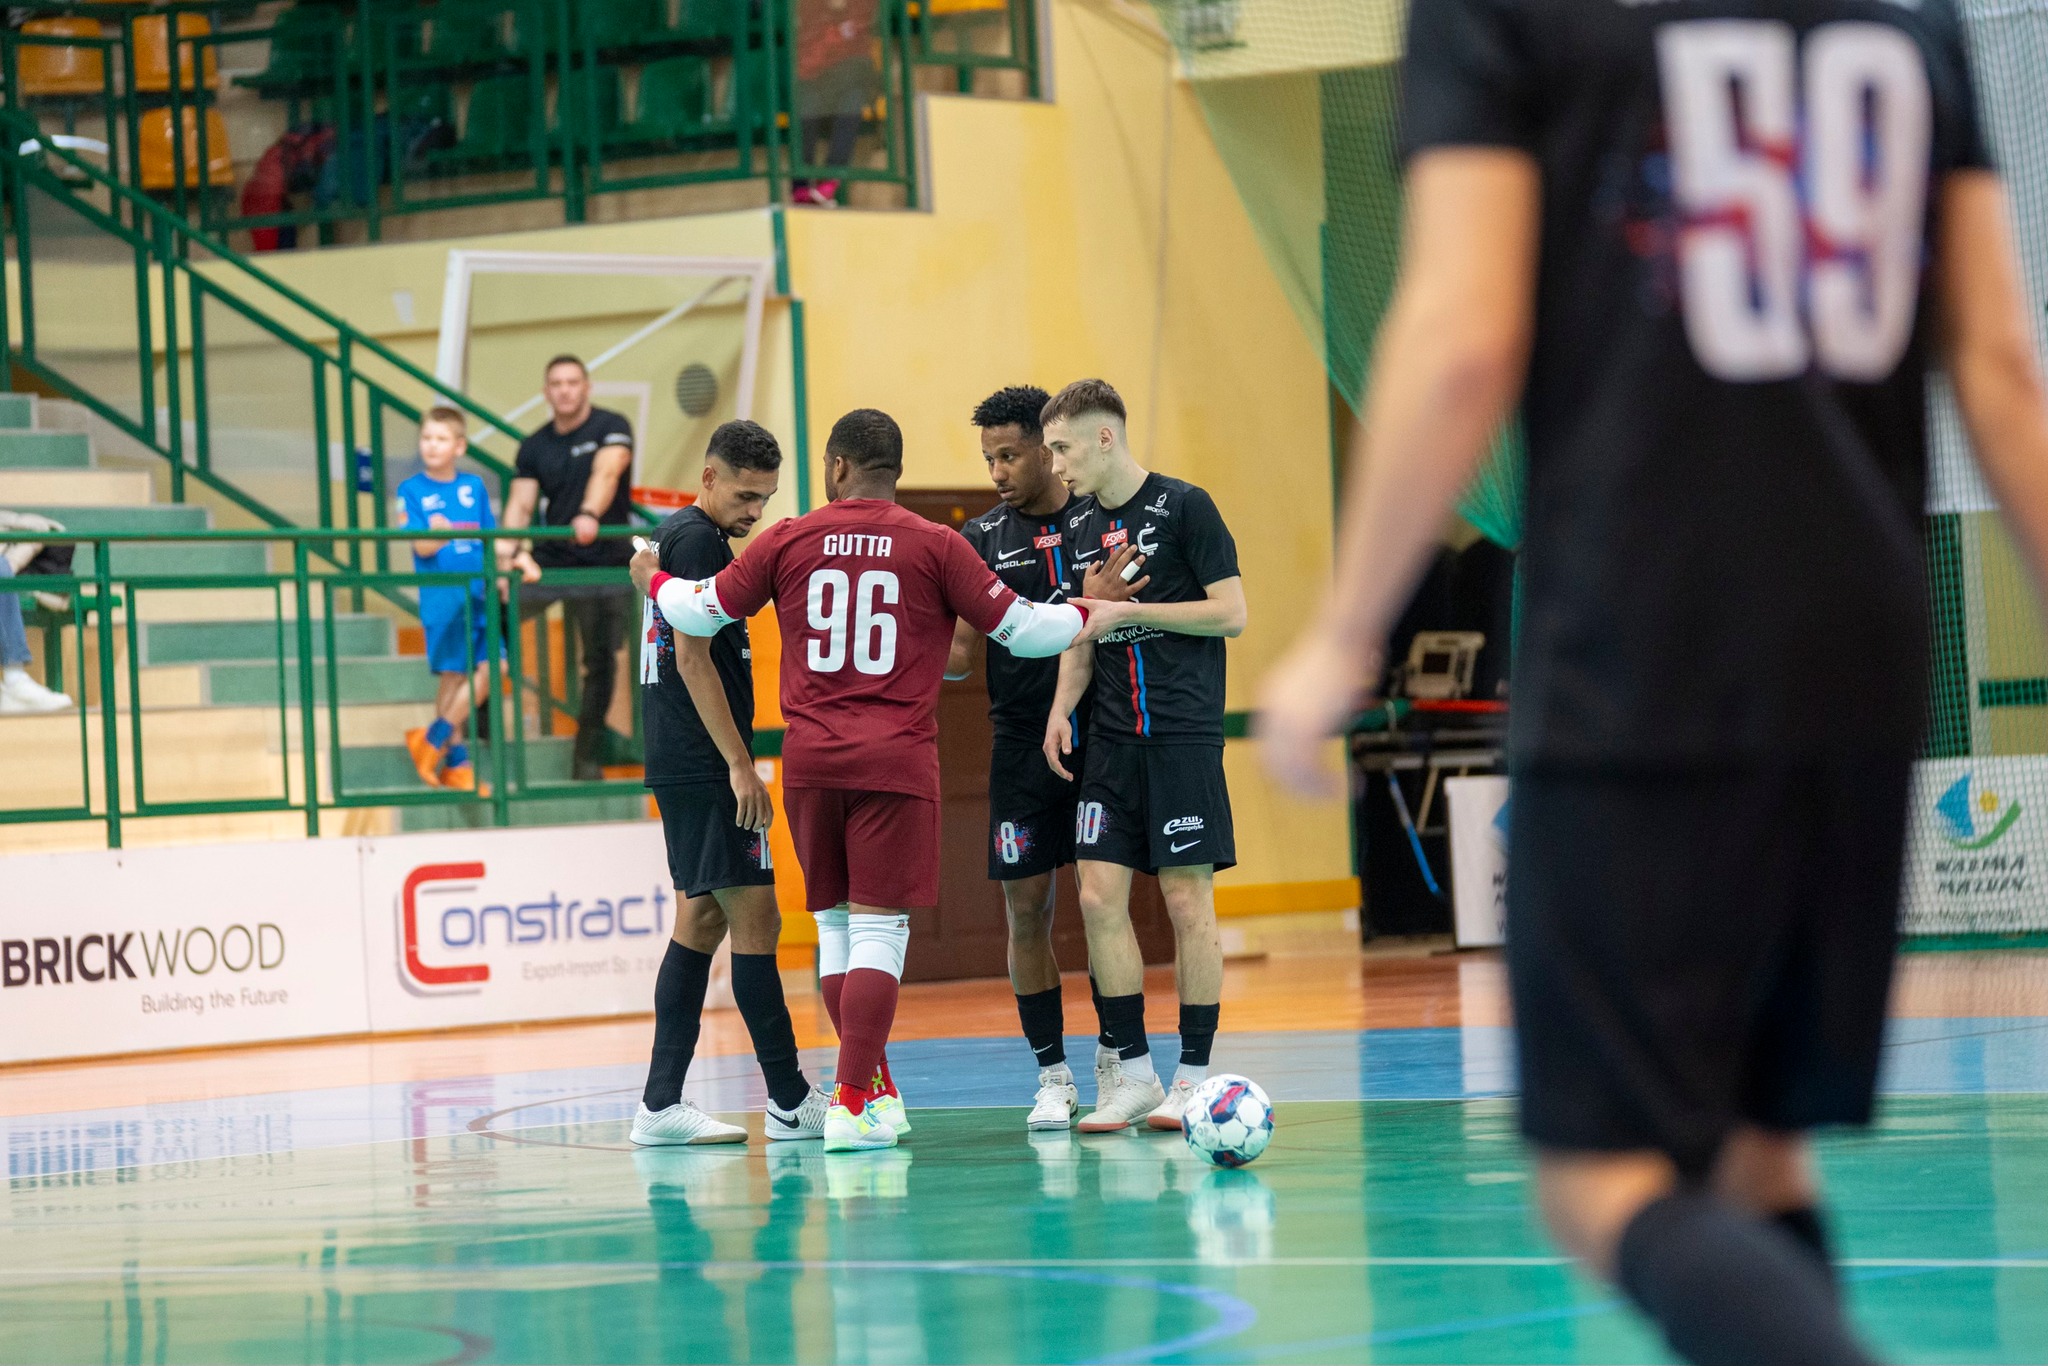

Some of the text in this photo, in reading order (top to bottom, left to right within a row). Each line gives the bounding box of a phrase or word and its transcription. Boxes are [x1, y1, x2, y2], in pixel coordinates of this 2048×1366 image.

[1655, 18, 1932, 383] 59
[823, 534, 893, 558] GUTTA
[807, 569, 899, 675] 96
[1000, 821, 1019, 863] 8
[1, 923, 285, 987] BRICKWOOD
[141, 986, 289, 1015] Building the Future
